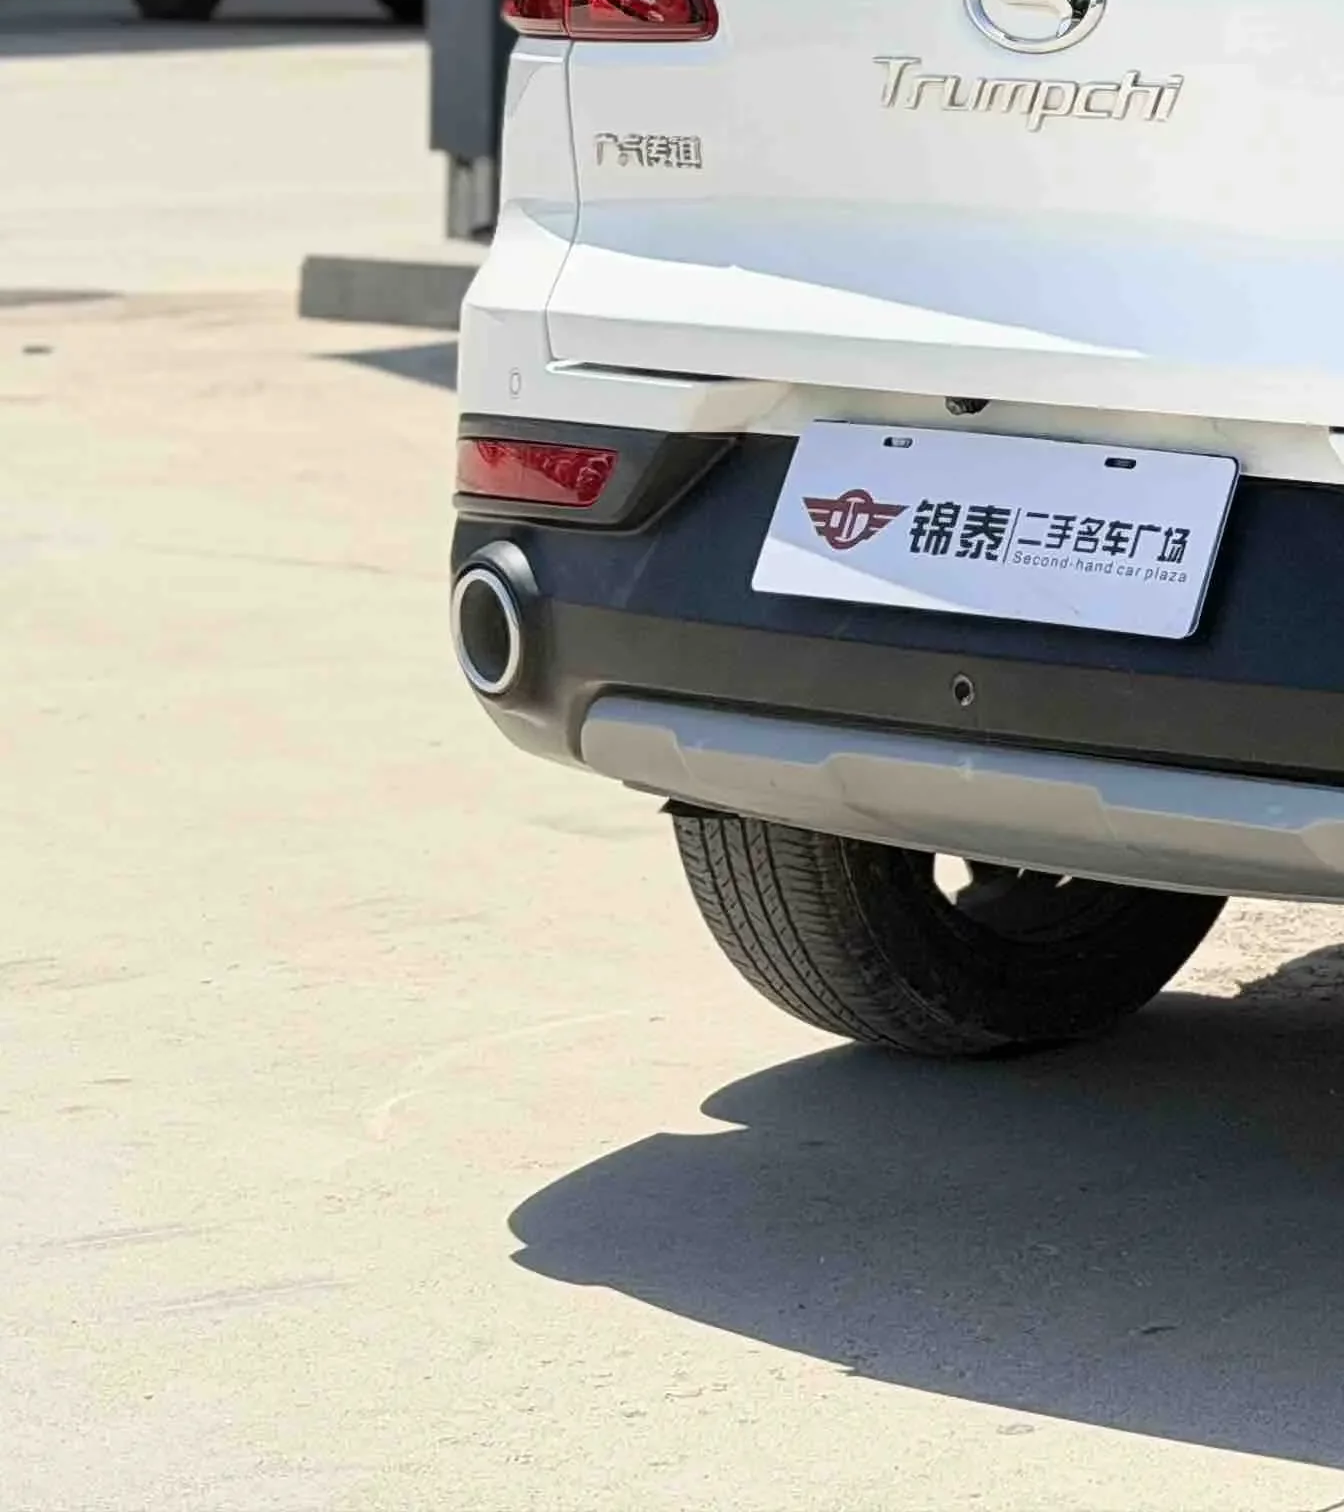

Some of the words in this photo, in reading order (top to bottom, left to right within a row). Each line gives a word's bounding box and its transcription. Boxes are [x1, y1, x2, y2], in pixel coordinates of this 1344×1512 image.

[873, 56, 1184, 131] Trumpchi
[909, 499, 1011, 561] 锦泰
[1017, 511, 1190, 564] 二手名车广场
[1012, 549, 1114, 575] Second-hand
[1115, 564, 1142, 579] car
[1143, 566, 1188, 584] plaza
